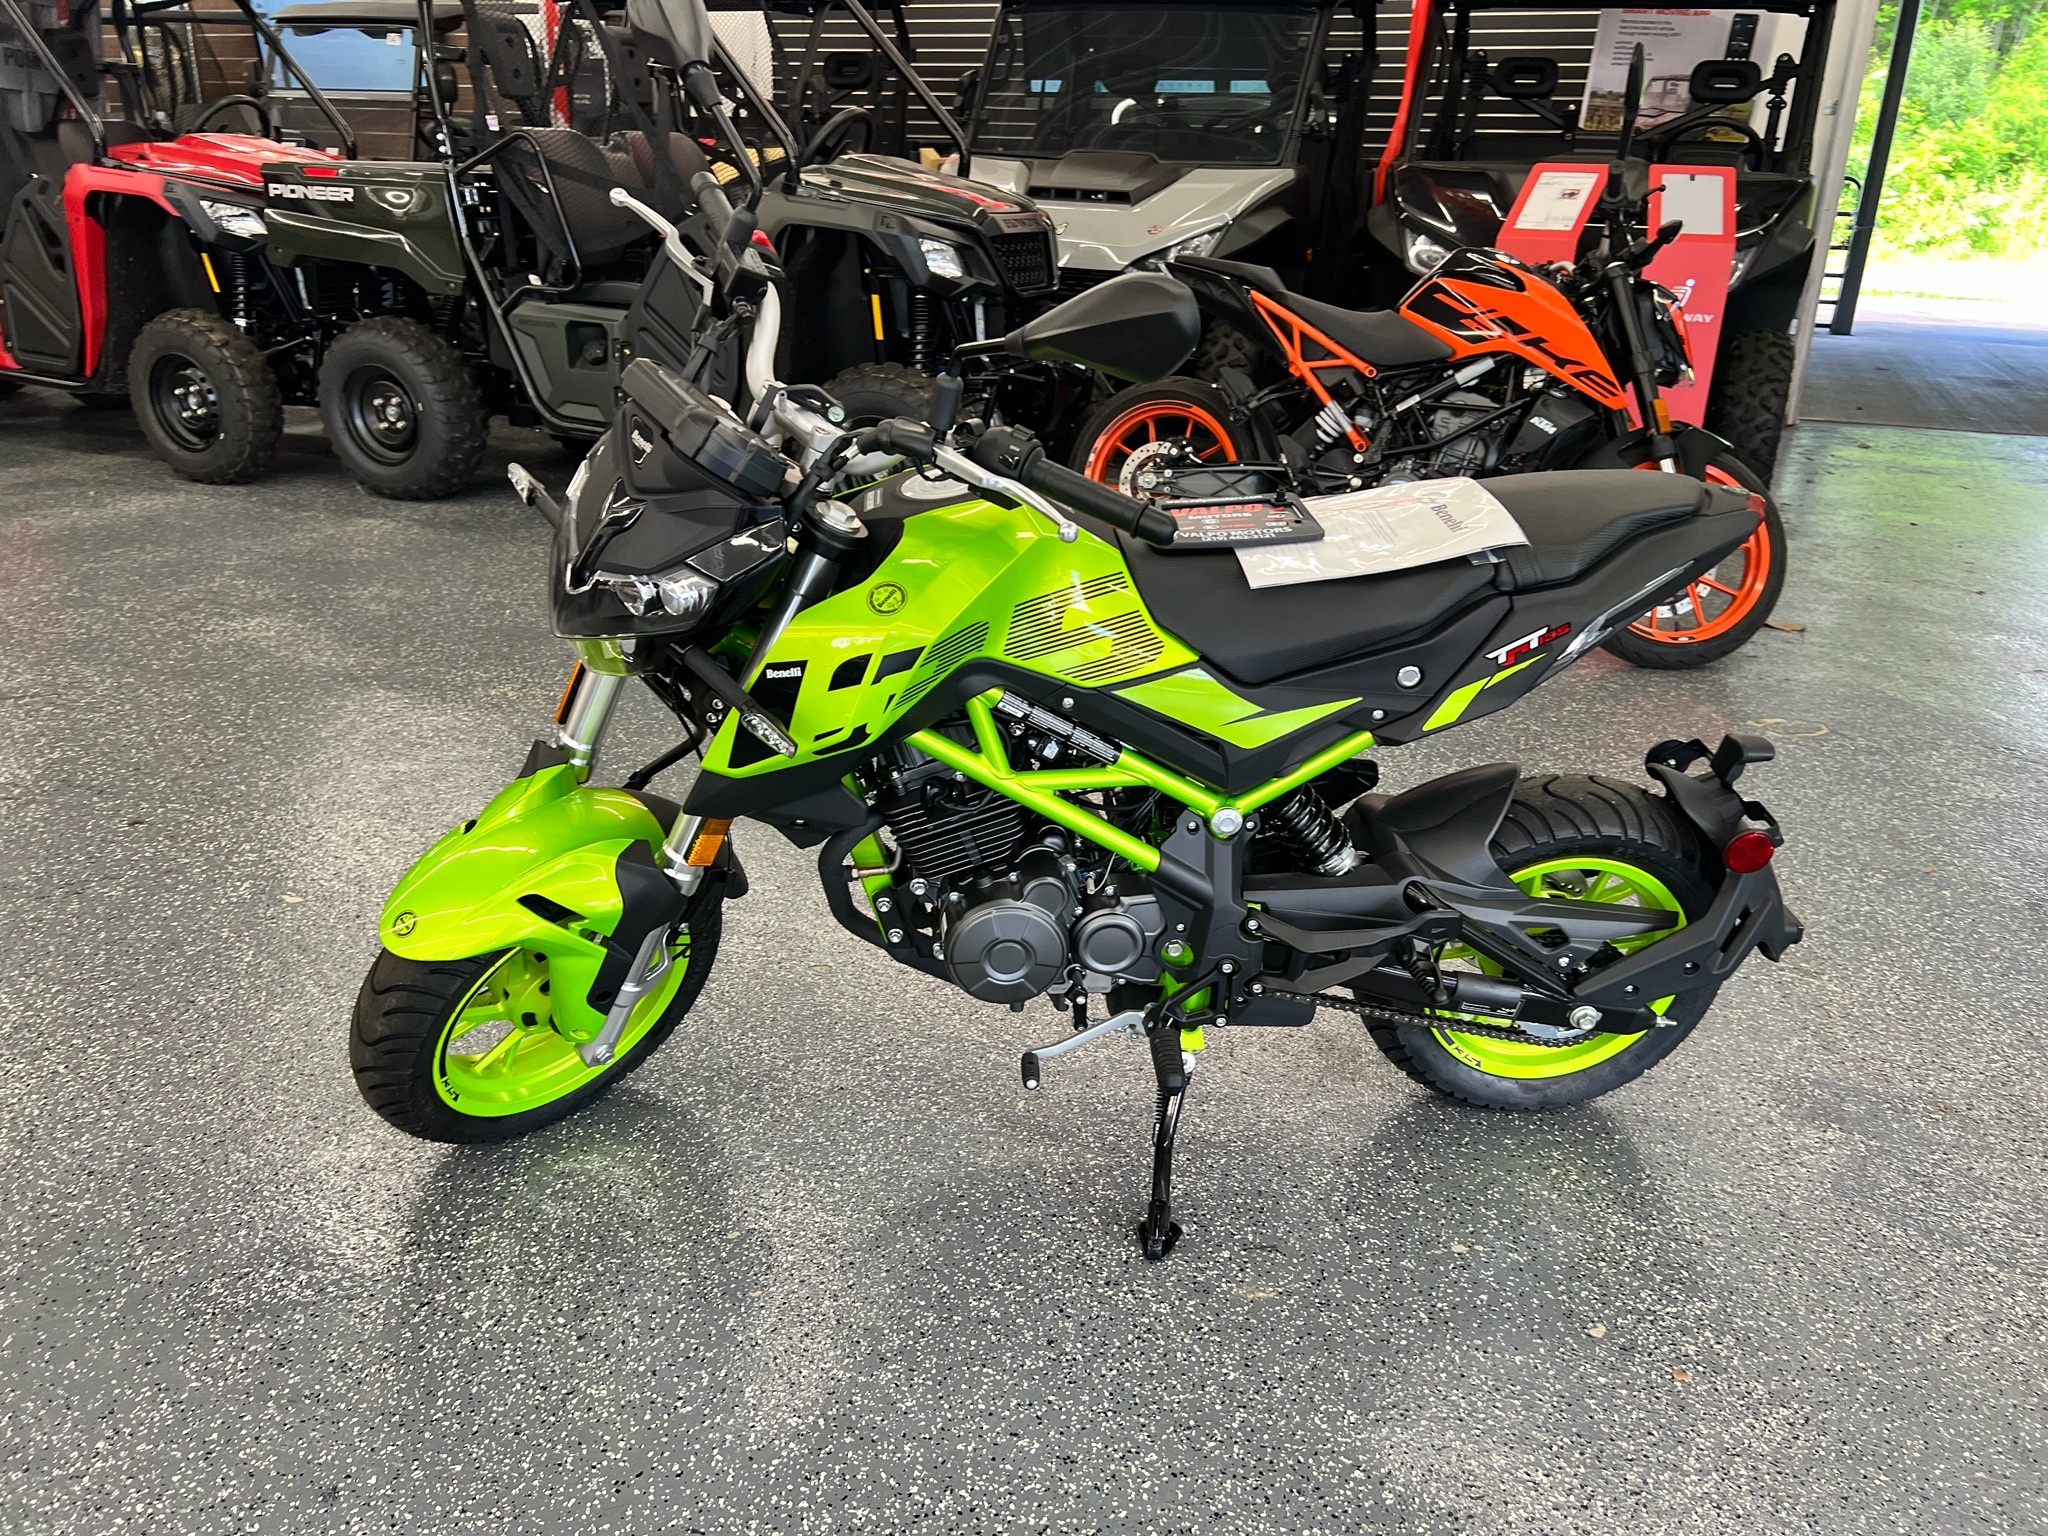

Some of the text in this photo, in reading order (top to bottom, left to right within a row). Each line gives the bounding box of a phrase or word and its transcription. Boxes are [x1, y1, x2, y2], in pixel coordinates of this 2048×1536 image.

[267, 183, 354, 202] PIONEER
[1529, 416, 1558, 435] KTM
[1170, 503, 1263, 516] VALPO
[1188, 512, 1252, 520] MOTORS
[1430, 504, 1468, 533] Benelli
[1231, 527, 1293, 536] MOTORS
[765, 666, 802, 679] Benelli
